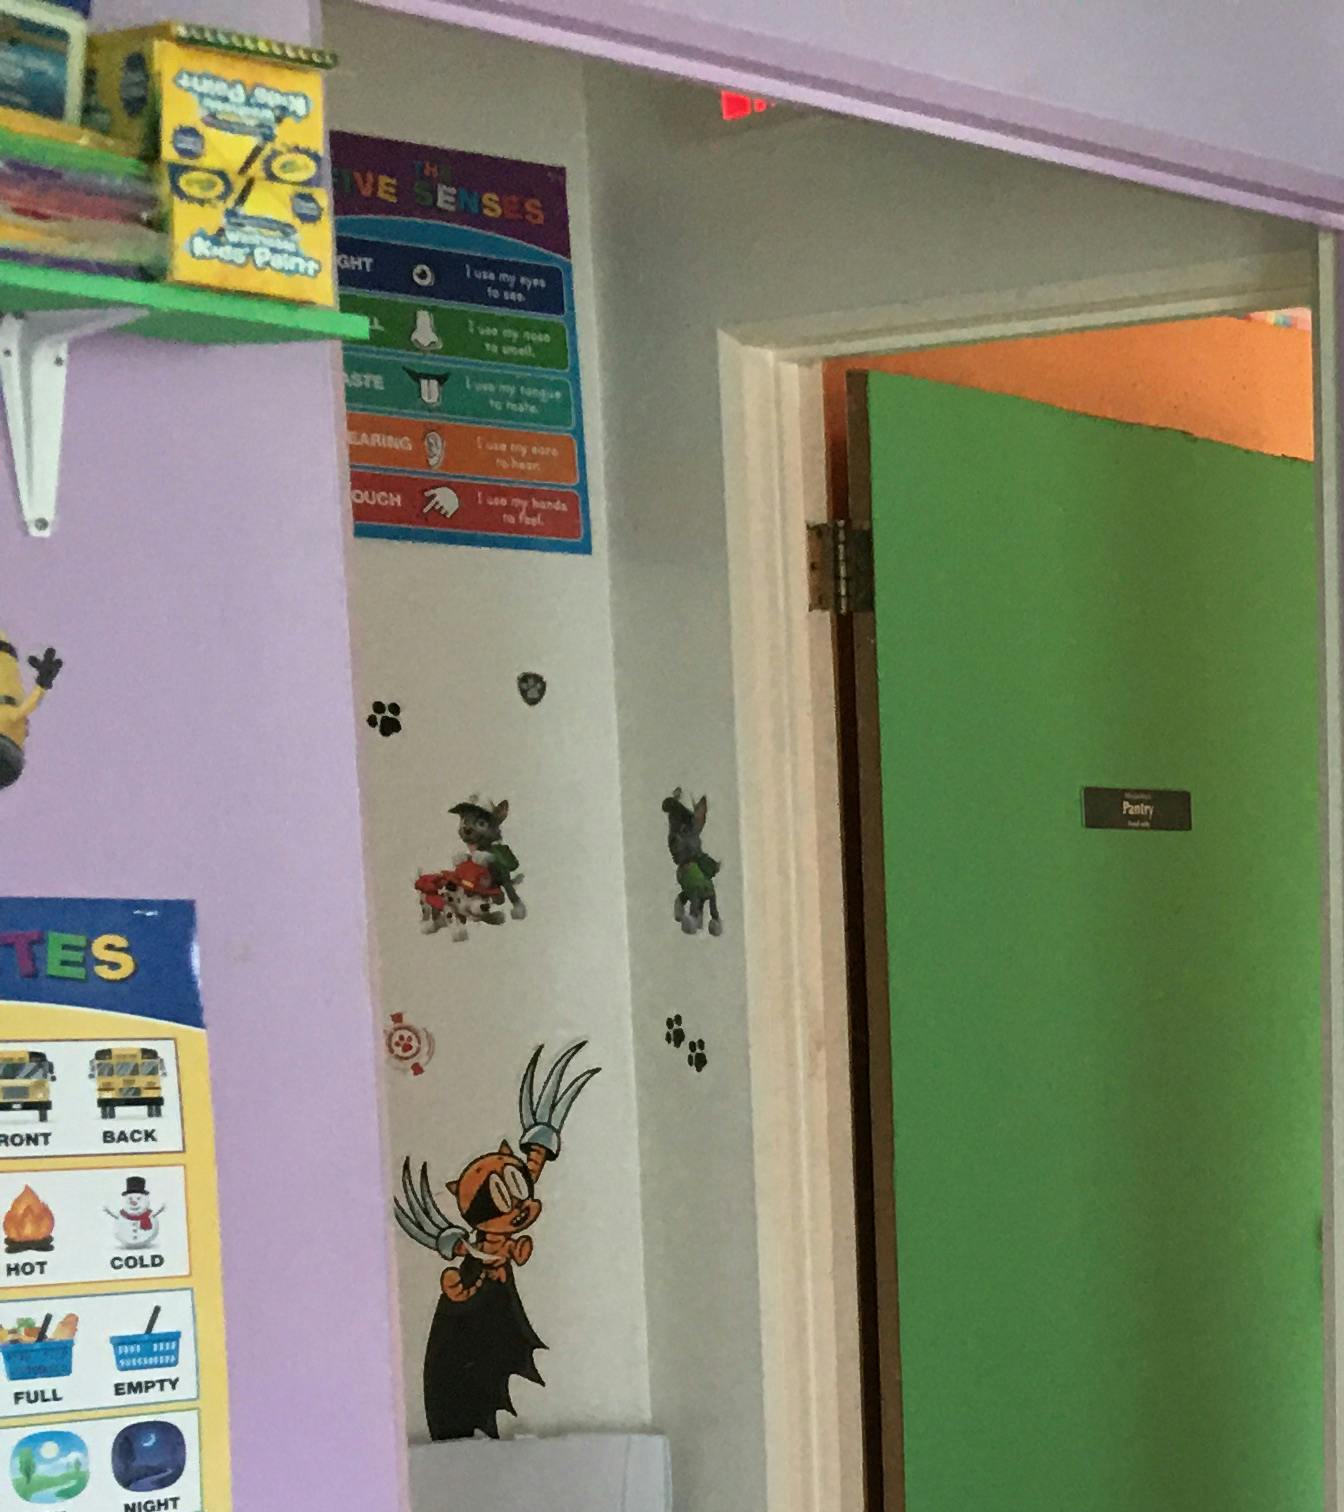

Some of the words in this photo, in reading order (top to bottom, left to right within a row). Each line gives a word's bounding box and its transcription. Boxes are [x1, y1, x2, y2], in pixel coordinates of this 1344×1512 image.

[414, 180, 544, 225] SENSES
[348, 431, 412, 451] EARING
[351, 489, 401, 506] OUCH
[1122, 800, 1154, 820] Pantry
[102, 1129, 157, 1144] BACK
[6, 1262, 48, 1276] HOT
[110, 1255, 165, 1269] COLD
[114, 1377, 179, 1396] EMPTY
[13, 1388, 63, 1405] FULL
